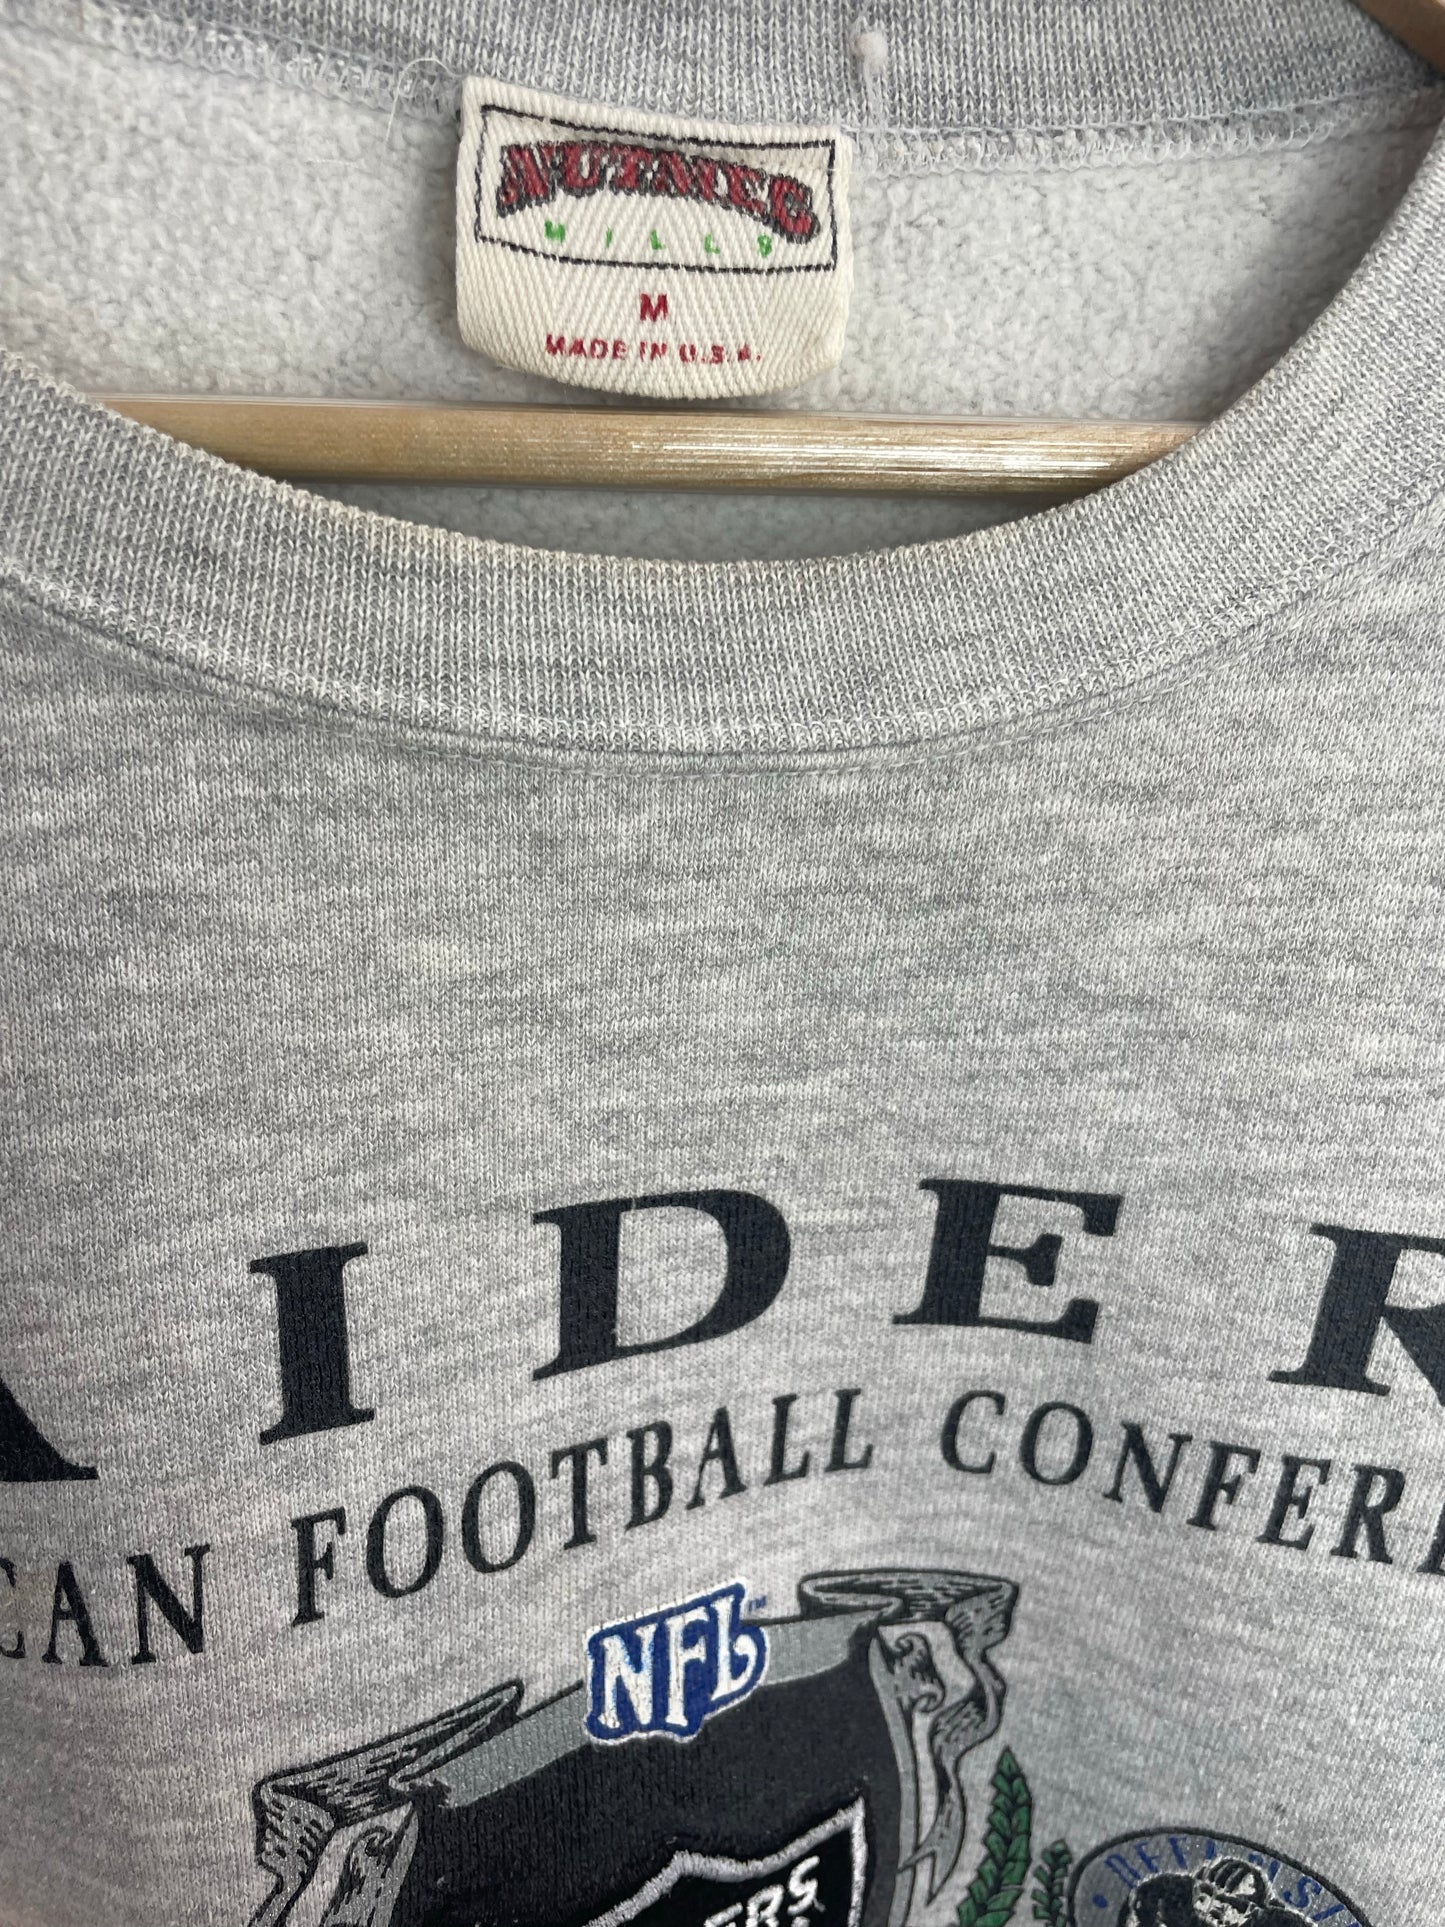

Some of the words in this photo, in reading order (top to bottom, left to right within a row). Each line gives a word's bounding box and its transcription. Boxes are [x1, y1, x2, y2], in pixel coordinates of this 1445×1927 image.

[545, 333, 627, 361] MADE
[639, 340, 668, 363] IN
[639, 293, 669, 322] M
[290, 1387, 874, 1627] FOOTBALL
[596, 1594, 759, 1730] NFL
